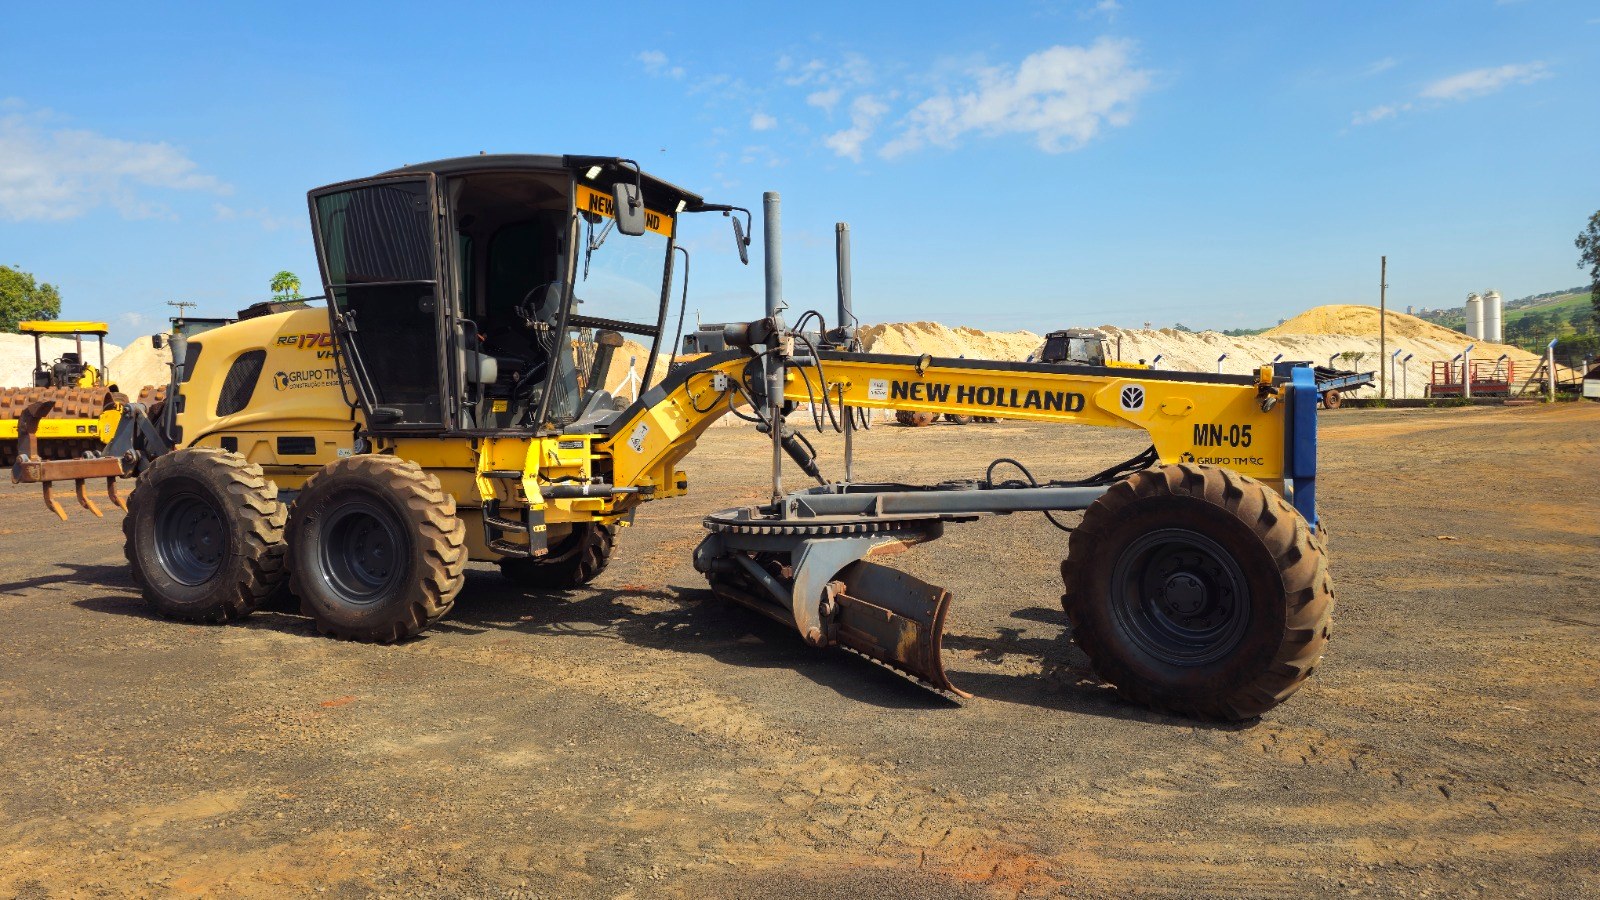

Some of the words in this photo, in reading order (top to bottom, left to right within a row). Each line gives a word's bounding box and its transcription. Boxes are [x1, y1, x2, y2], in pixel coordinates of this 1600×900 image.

[589, 193, 614, 216] NEW
[289, 369, 322, 382] GRUPO
[891, 380, 951, 402] NEW
[956, 385, 1086, 413] HOLLAND
[1193, 423, 1252, 448] MN-05
[1197, 456, 1231, 465] GRUPO
